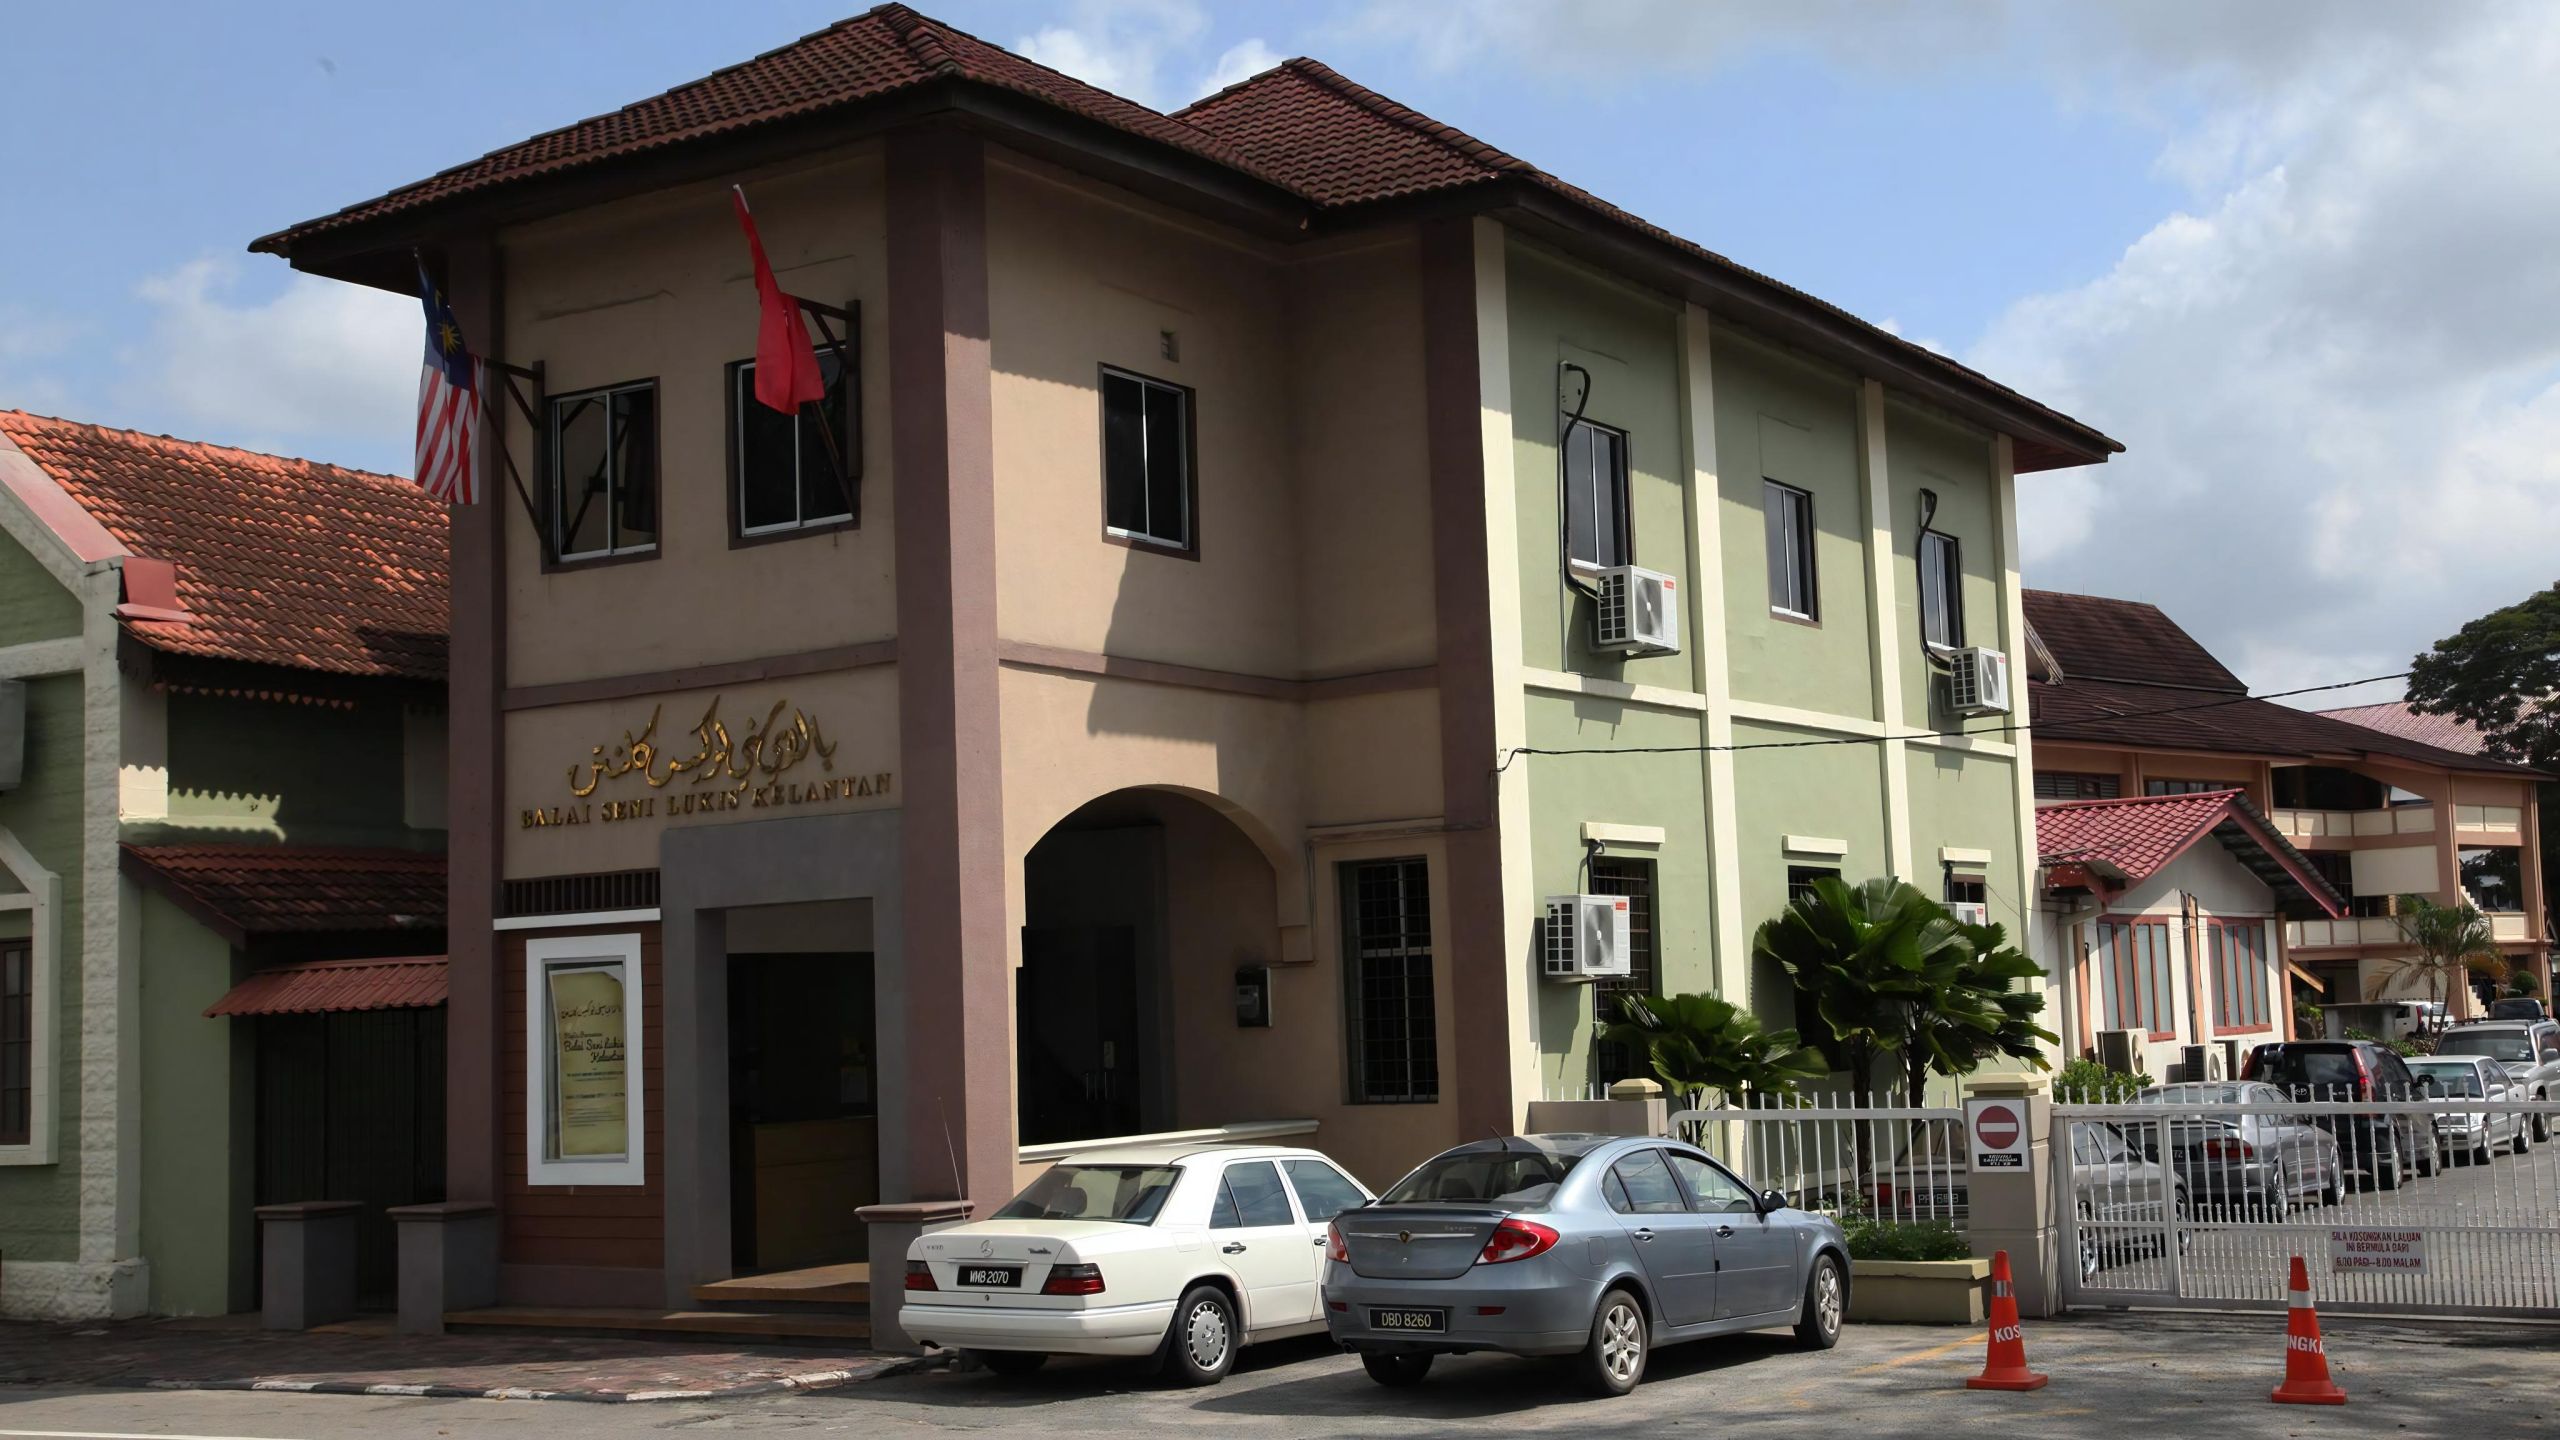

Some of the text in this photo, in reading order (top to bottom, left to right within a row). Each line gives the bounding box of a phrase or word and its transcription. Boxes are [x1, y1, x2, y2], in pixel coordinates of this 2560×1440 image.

[521, 772, 892, 829] BALAI SENI LUKIS KELANTAN
[2332, 1231, 2347, 1241] SILA
[2393, 1231, 2422, 1242] LALUAN
[2356, 1243, 2390, 1253] BERMULA
[2392, 1243, 2409, 1253] DARI
[2393, 1258, 2422, 1268] MALAM
[986, 1270, 1009, 1284] 2070
[1381, 1312, 1432, 1328] DBD 8260
[1994, 1324, 2021, 1343] KOS
